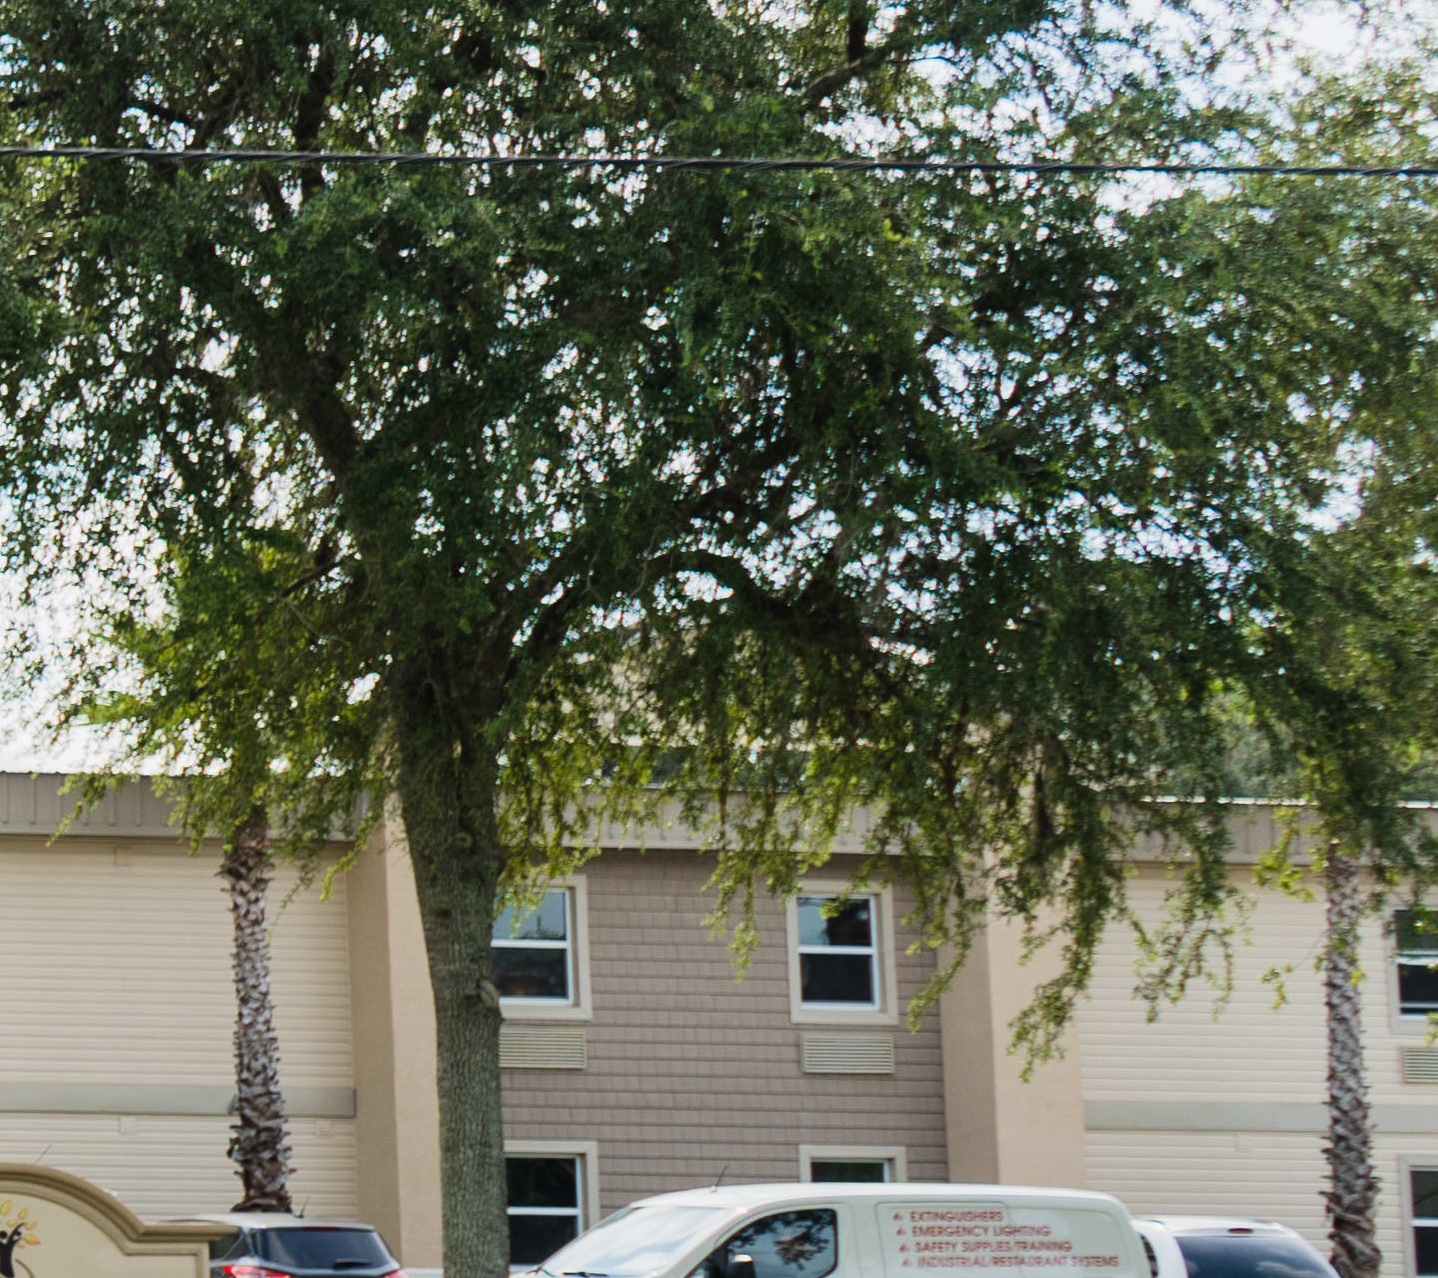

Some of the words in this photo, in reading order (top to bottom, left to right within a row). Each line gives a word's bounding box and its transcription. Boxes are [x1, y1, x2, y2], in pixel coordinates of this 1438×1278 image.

[910, 1211, 1003, 1222] EXTINGUISHERS
[912, 1225, 989, 1237] EMERGENCY
[993, 1225, 1051, 1236] LIGHTING
[915, 1241, 958, 1253] SAFETY
[1071, 1255, 1120, 1267] SYSTEMS
